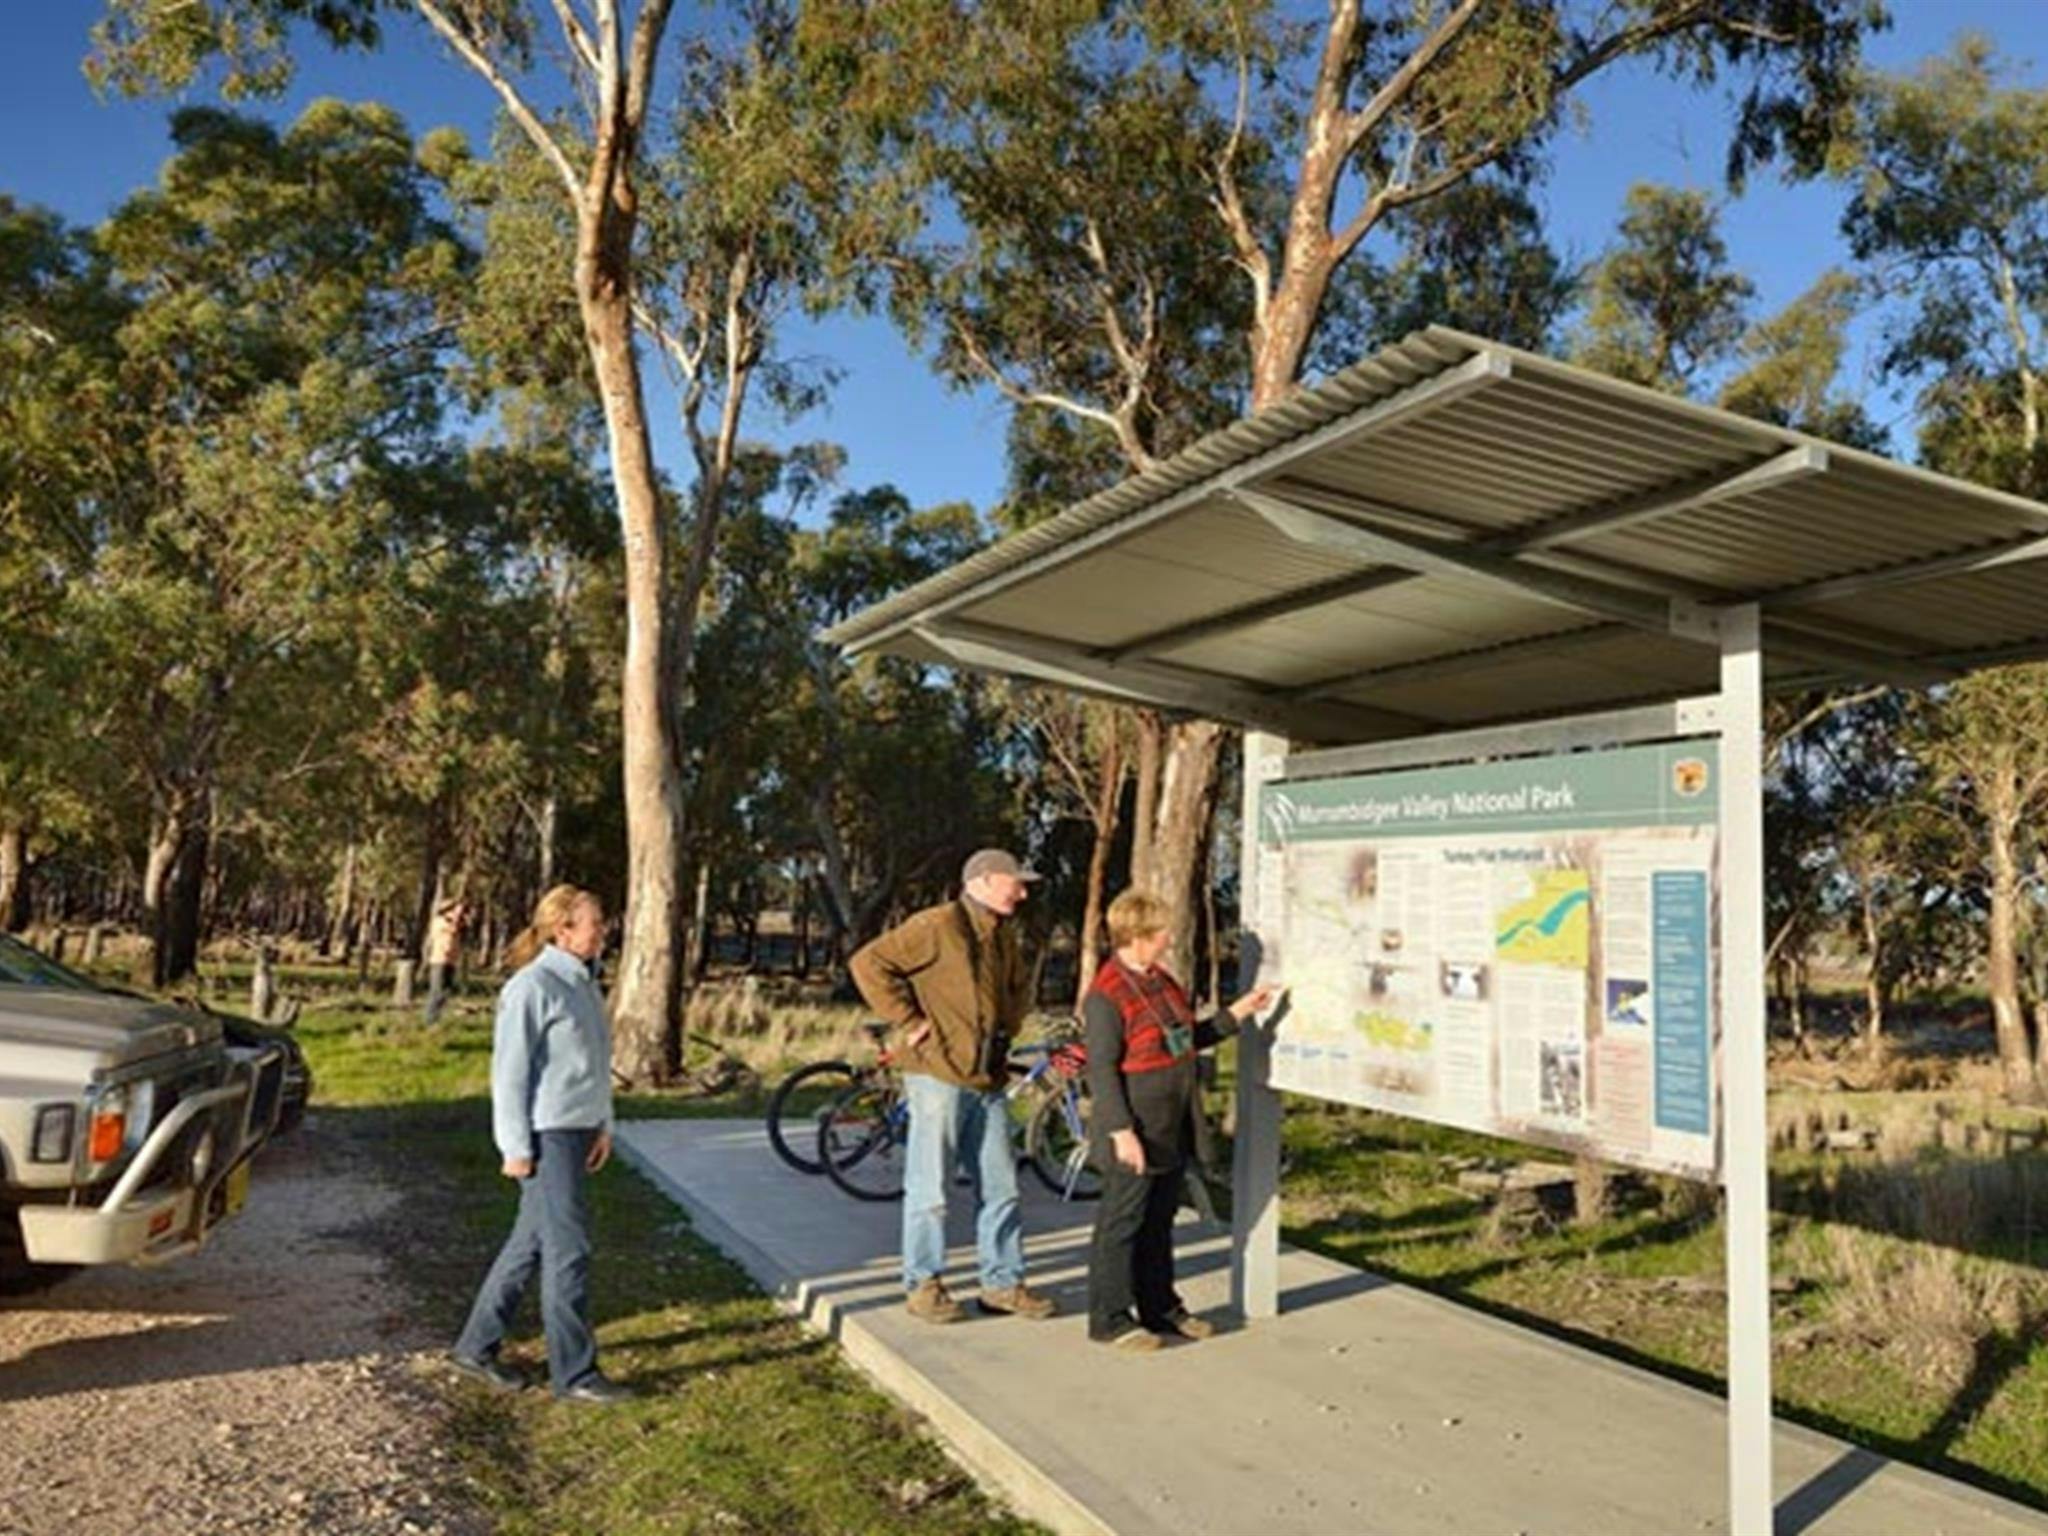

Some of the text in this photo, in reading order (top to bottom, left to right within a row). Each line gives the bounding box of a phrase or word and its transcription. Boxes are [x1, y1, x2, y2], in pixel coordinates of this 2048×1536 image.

[1401, 793, 1449, 820] Valley
[1452, 785, 1527, 814] National
[1530, 784, 1575, 811] Park
